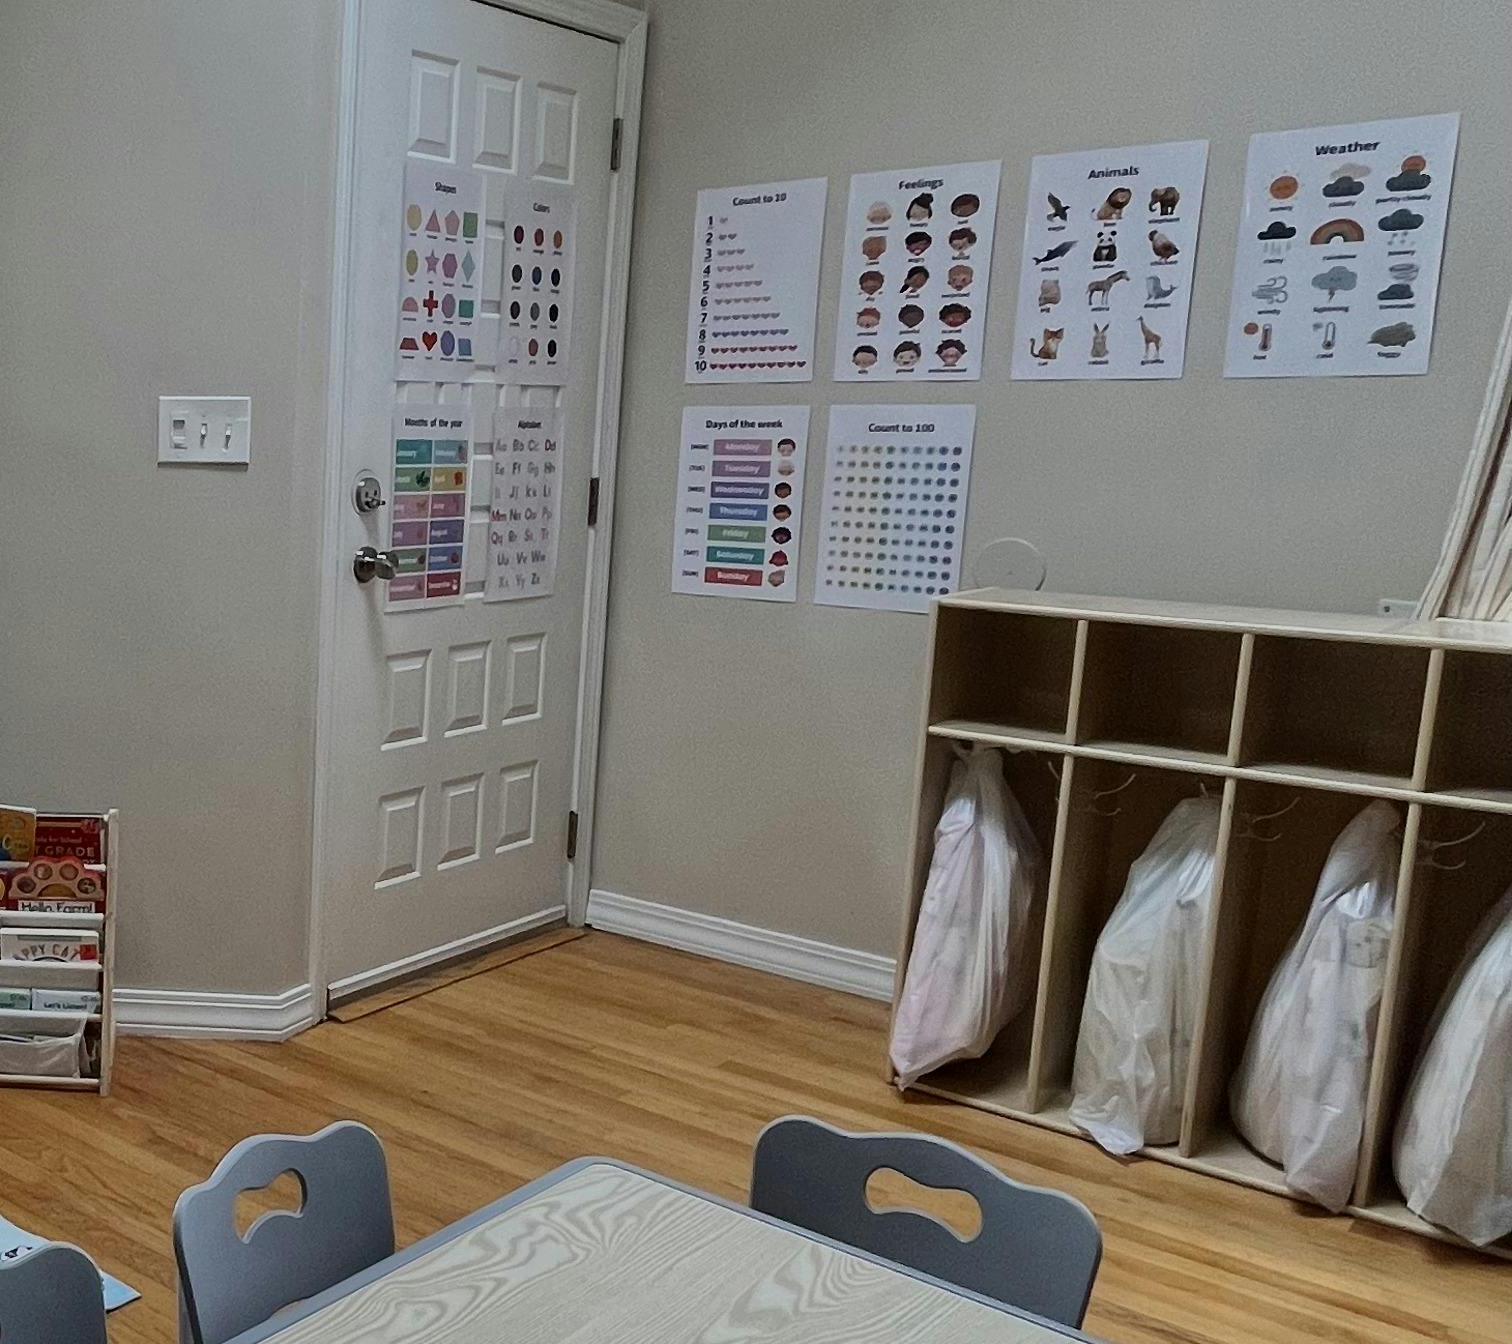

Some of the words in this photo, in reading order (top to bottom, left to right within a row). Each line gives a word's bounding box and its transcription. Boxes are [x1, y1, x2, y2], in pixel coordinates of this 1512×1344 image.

[1314, 141, 1380, 156] Weather
[1088, 166, 1139, 179] Animals
[898, 179, 943, 190] Feelings
[733, 197, 761, 206] Count
[709, 216, 713, 225] 1
[706, 232, 713, 243] 2
[703, 265, 711, 274] 4
[703, 281, 710, 291] 5
[700, 296, 708, 307] 6
[701, 313, 707, 323] 7
[698, 345, 705, 355] 9
[695, 360, 707, 371] 10
[706, 420, 727, 429] Days
[729, 419, 738, 428] of
[740, 420, 756, 428] the
[868, 423, 899, 433] Count
[902, 424, 913, 433] to
[915, 423, 935, 433] 100
[44, 845, 95, 857] GRADE
